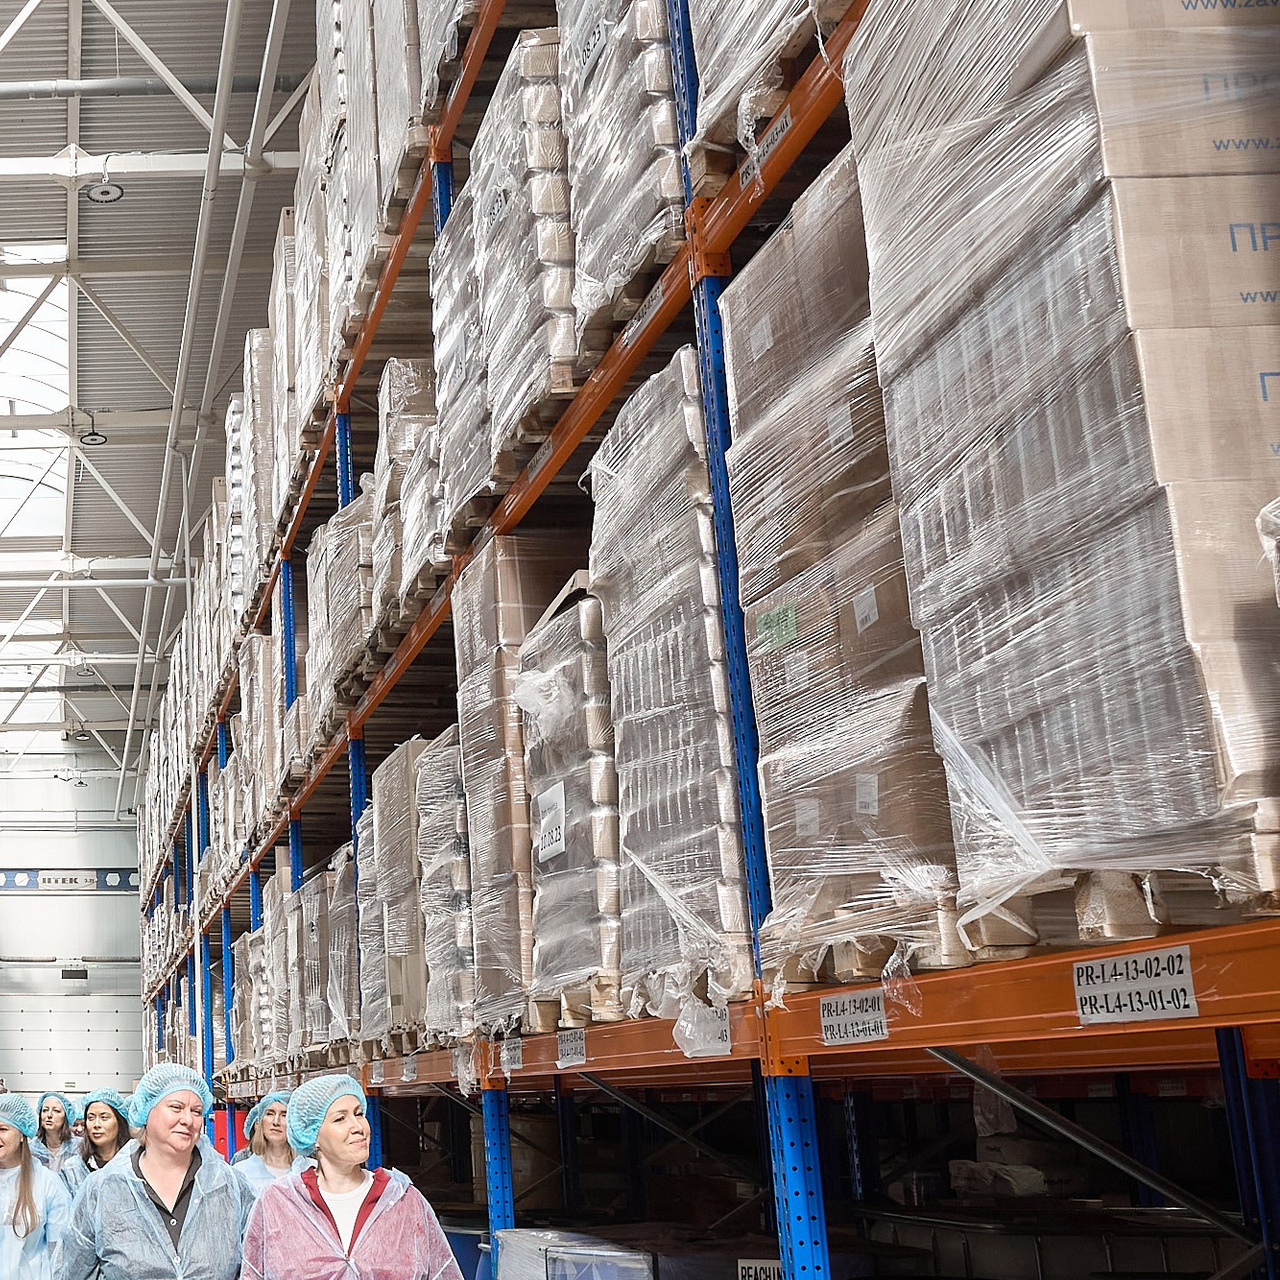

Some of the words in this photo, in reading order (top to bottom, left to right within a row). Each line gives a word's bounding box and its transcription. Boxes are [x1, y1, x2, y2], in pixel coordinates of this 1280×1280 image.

[1076, 953, 1184, 987] PR-L4-13-02-02
[822, 996, 881, 1018] PR-L4-13-02-01
[1080, 987, 1191, 1015] PR-L4-13-01-02
[824, 1020, 885, 1040] PR-L4-13-01-01
